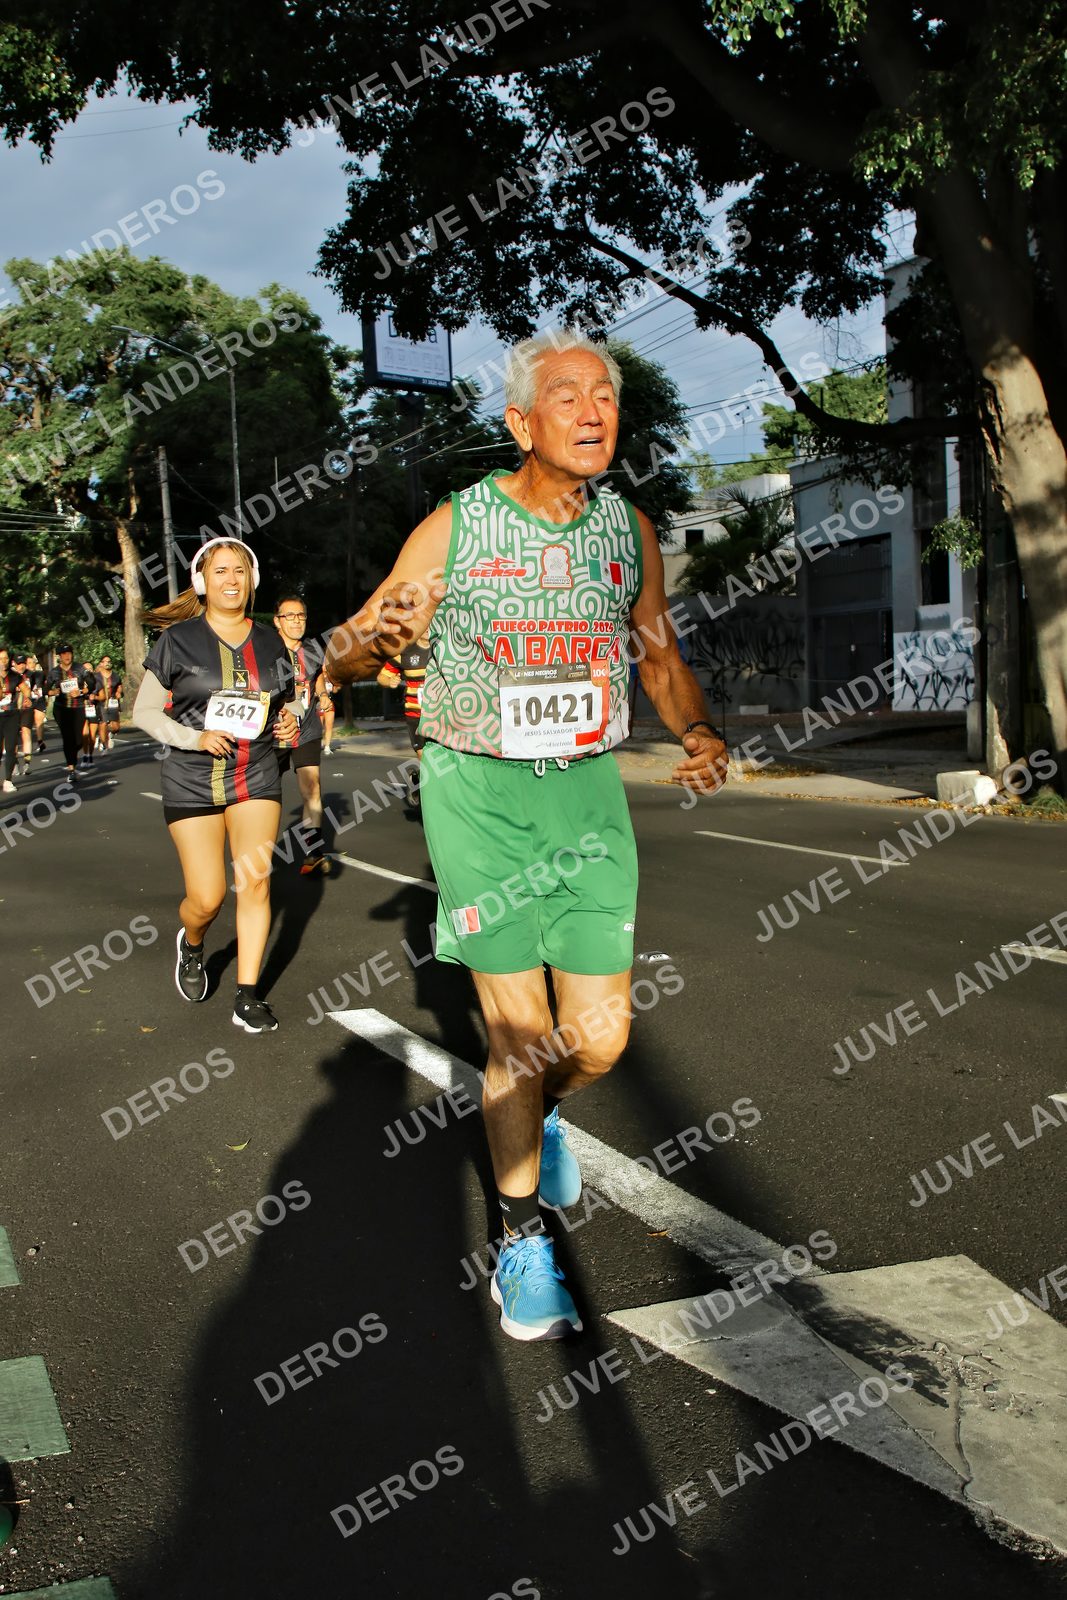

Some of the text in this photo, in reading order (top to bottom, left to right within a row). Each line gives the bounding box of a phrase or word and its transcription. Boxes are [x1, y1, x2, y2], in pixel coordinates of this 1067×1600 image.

[468, 568, 527, 578] GERSO
[491, 620, 615, 633] FUEGO PATRIO 2025
[476, 635, 621, 665] LA BARCA
[214, 701, 257, 721] 2647
[507, 692, 594, 728] 10421
